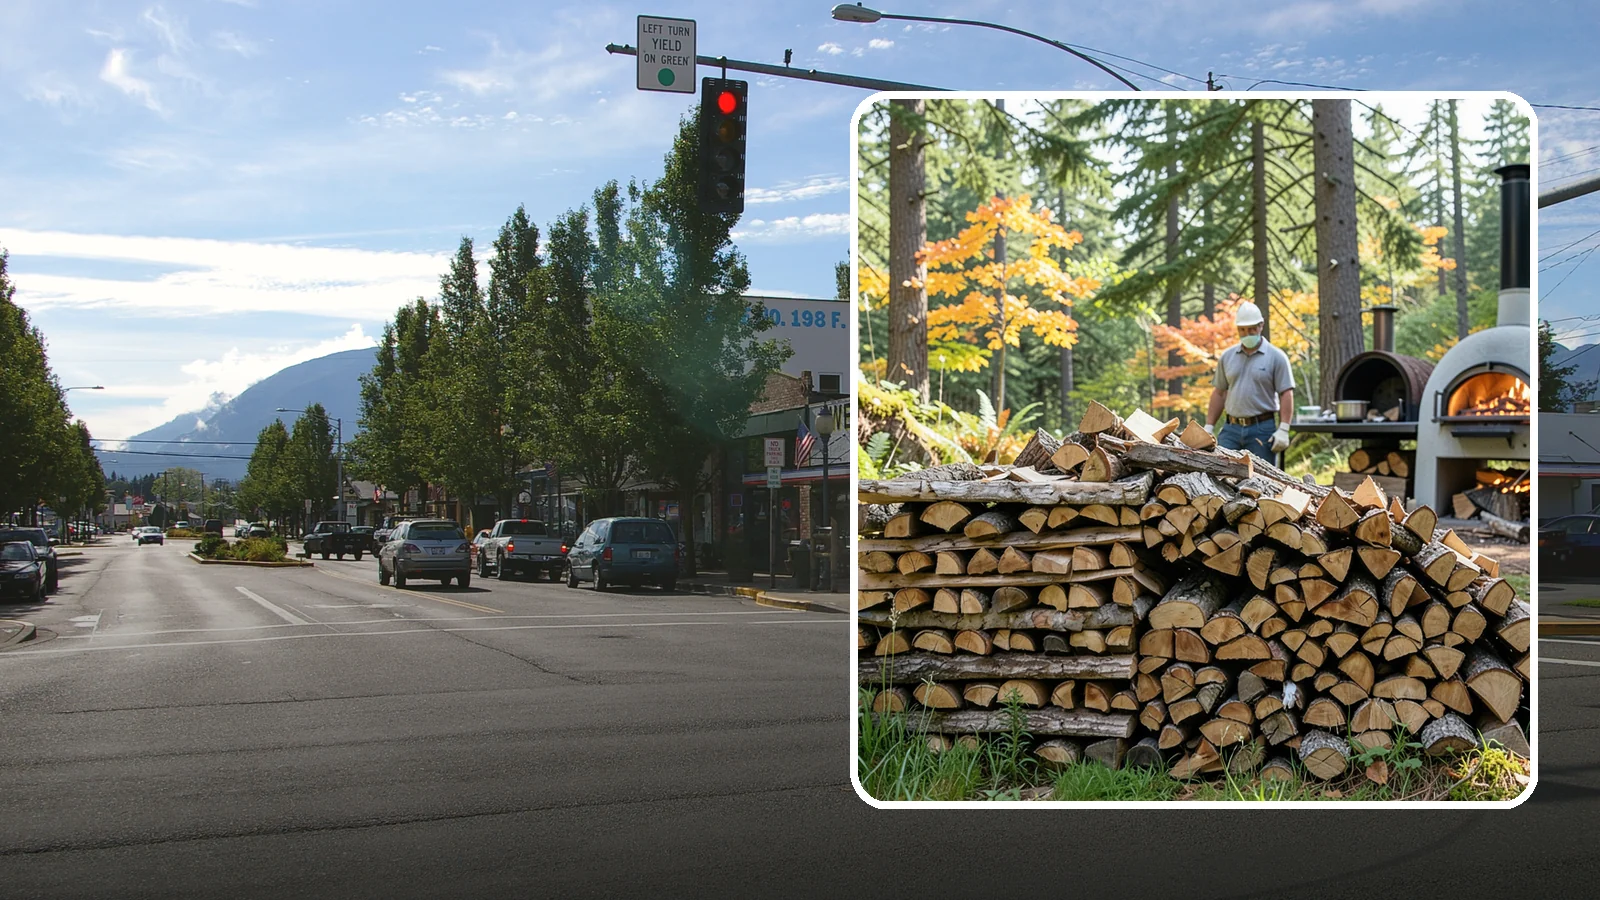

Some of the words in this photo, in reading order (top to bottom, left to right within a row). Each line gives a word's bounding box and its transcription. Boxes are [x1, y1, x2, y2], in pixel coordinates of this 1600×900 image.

[642, 24, 663, 34] LEFT
[668, 25, 690, 36] TURN
[652, 38, 682, 51] YIELD
[644, 53, 656, 63] ON
[661, 54, 689, 66] GREEN
[791, 309, 826, 328] 198
[831, 311, 847, 329] F.
